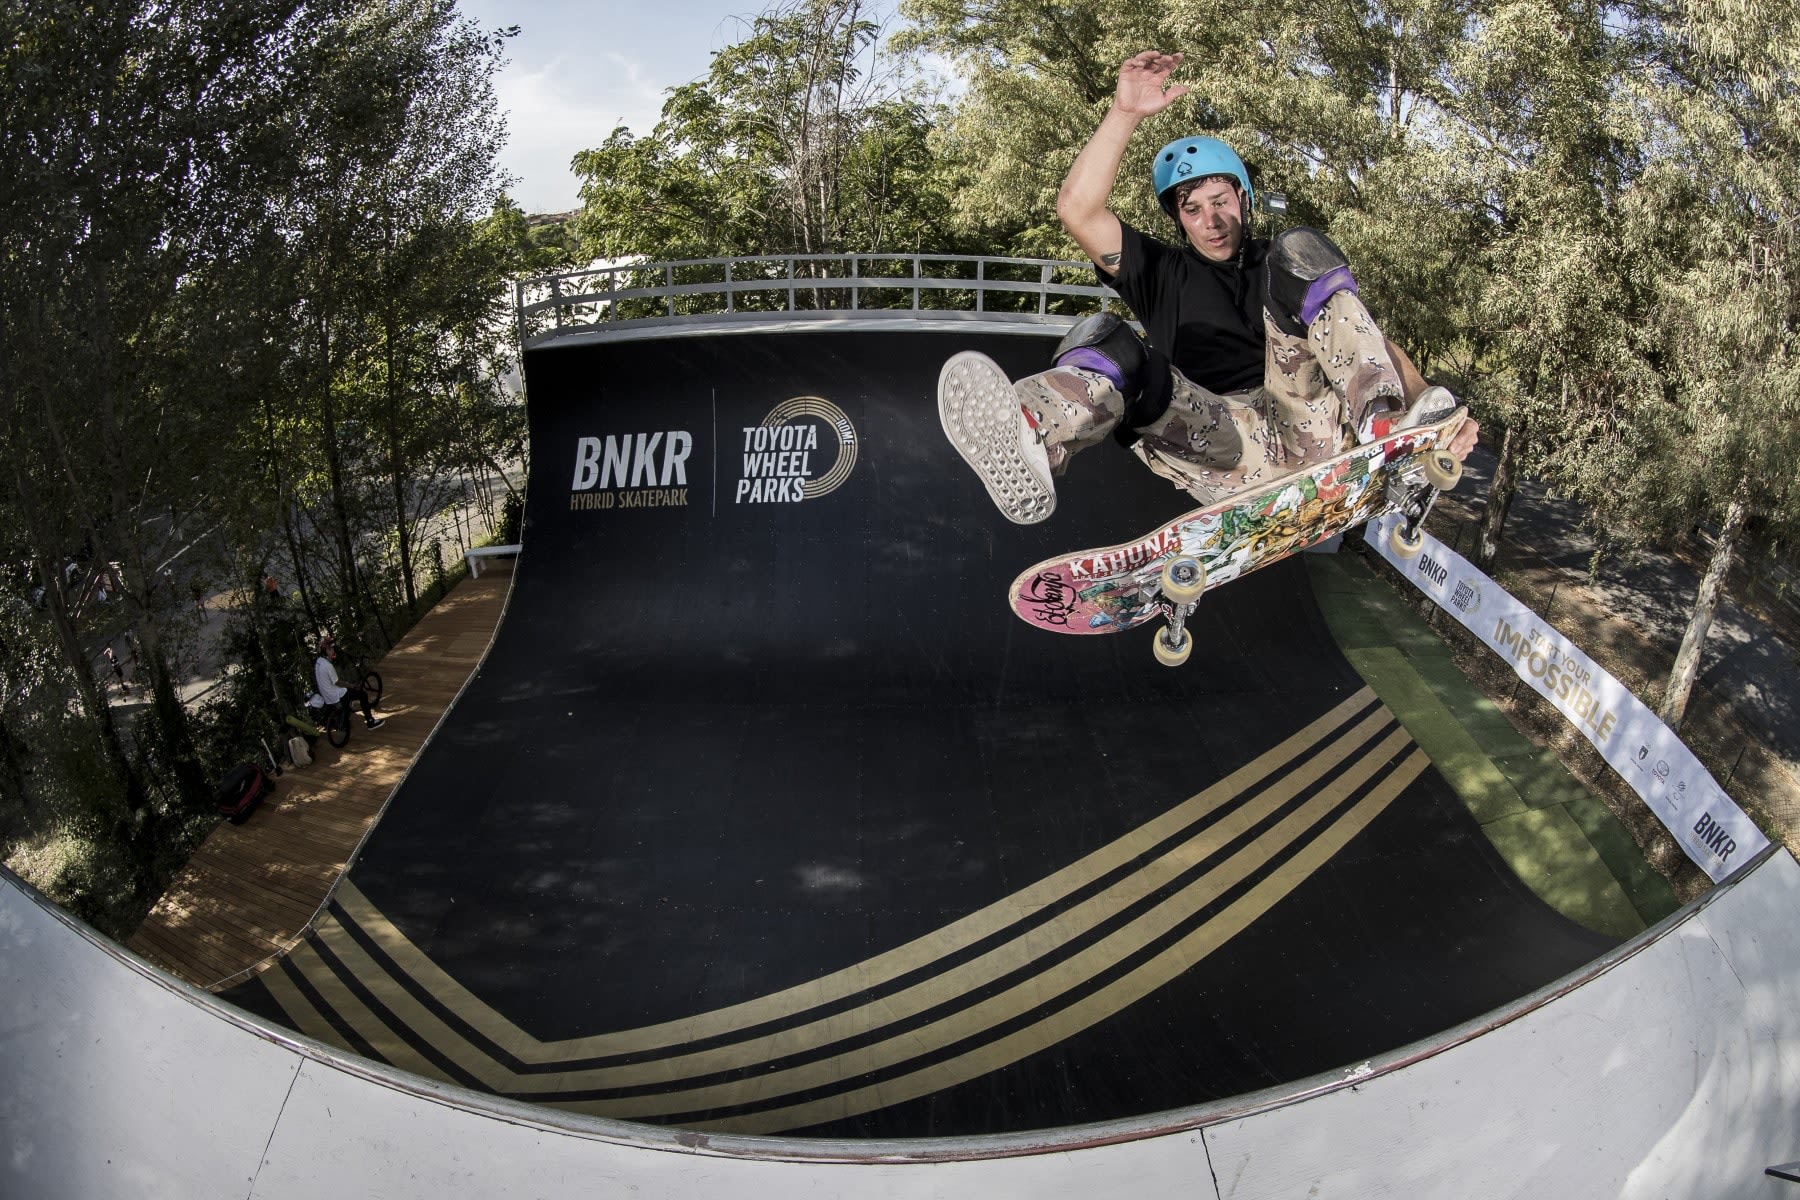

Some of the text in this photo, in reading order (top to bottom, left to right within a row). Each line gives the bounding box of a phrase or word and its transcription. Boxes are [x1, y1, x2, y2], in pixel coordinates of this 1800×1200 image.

[743, 425, 817, 452] TOYOTA
[836, 417, 855, 446] ROME
[571, 431, 693, 491] BNKR
[743, 451, 812, 478] WHEEL
[570, 488, 689, 511] HYBRID SKATEPARK
[735, 477, 806, 504] PARKS
[1069, 528, 1181, 577] KAHUNA
[1418, 553, 1448, 587] BNKR
[1529, 628, 1591, 686] START YOUR
[1493, 617, 1616, 742] IMPOSSIBLE
[1693, 811, 1737, 862] BNKR
